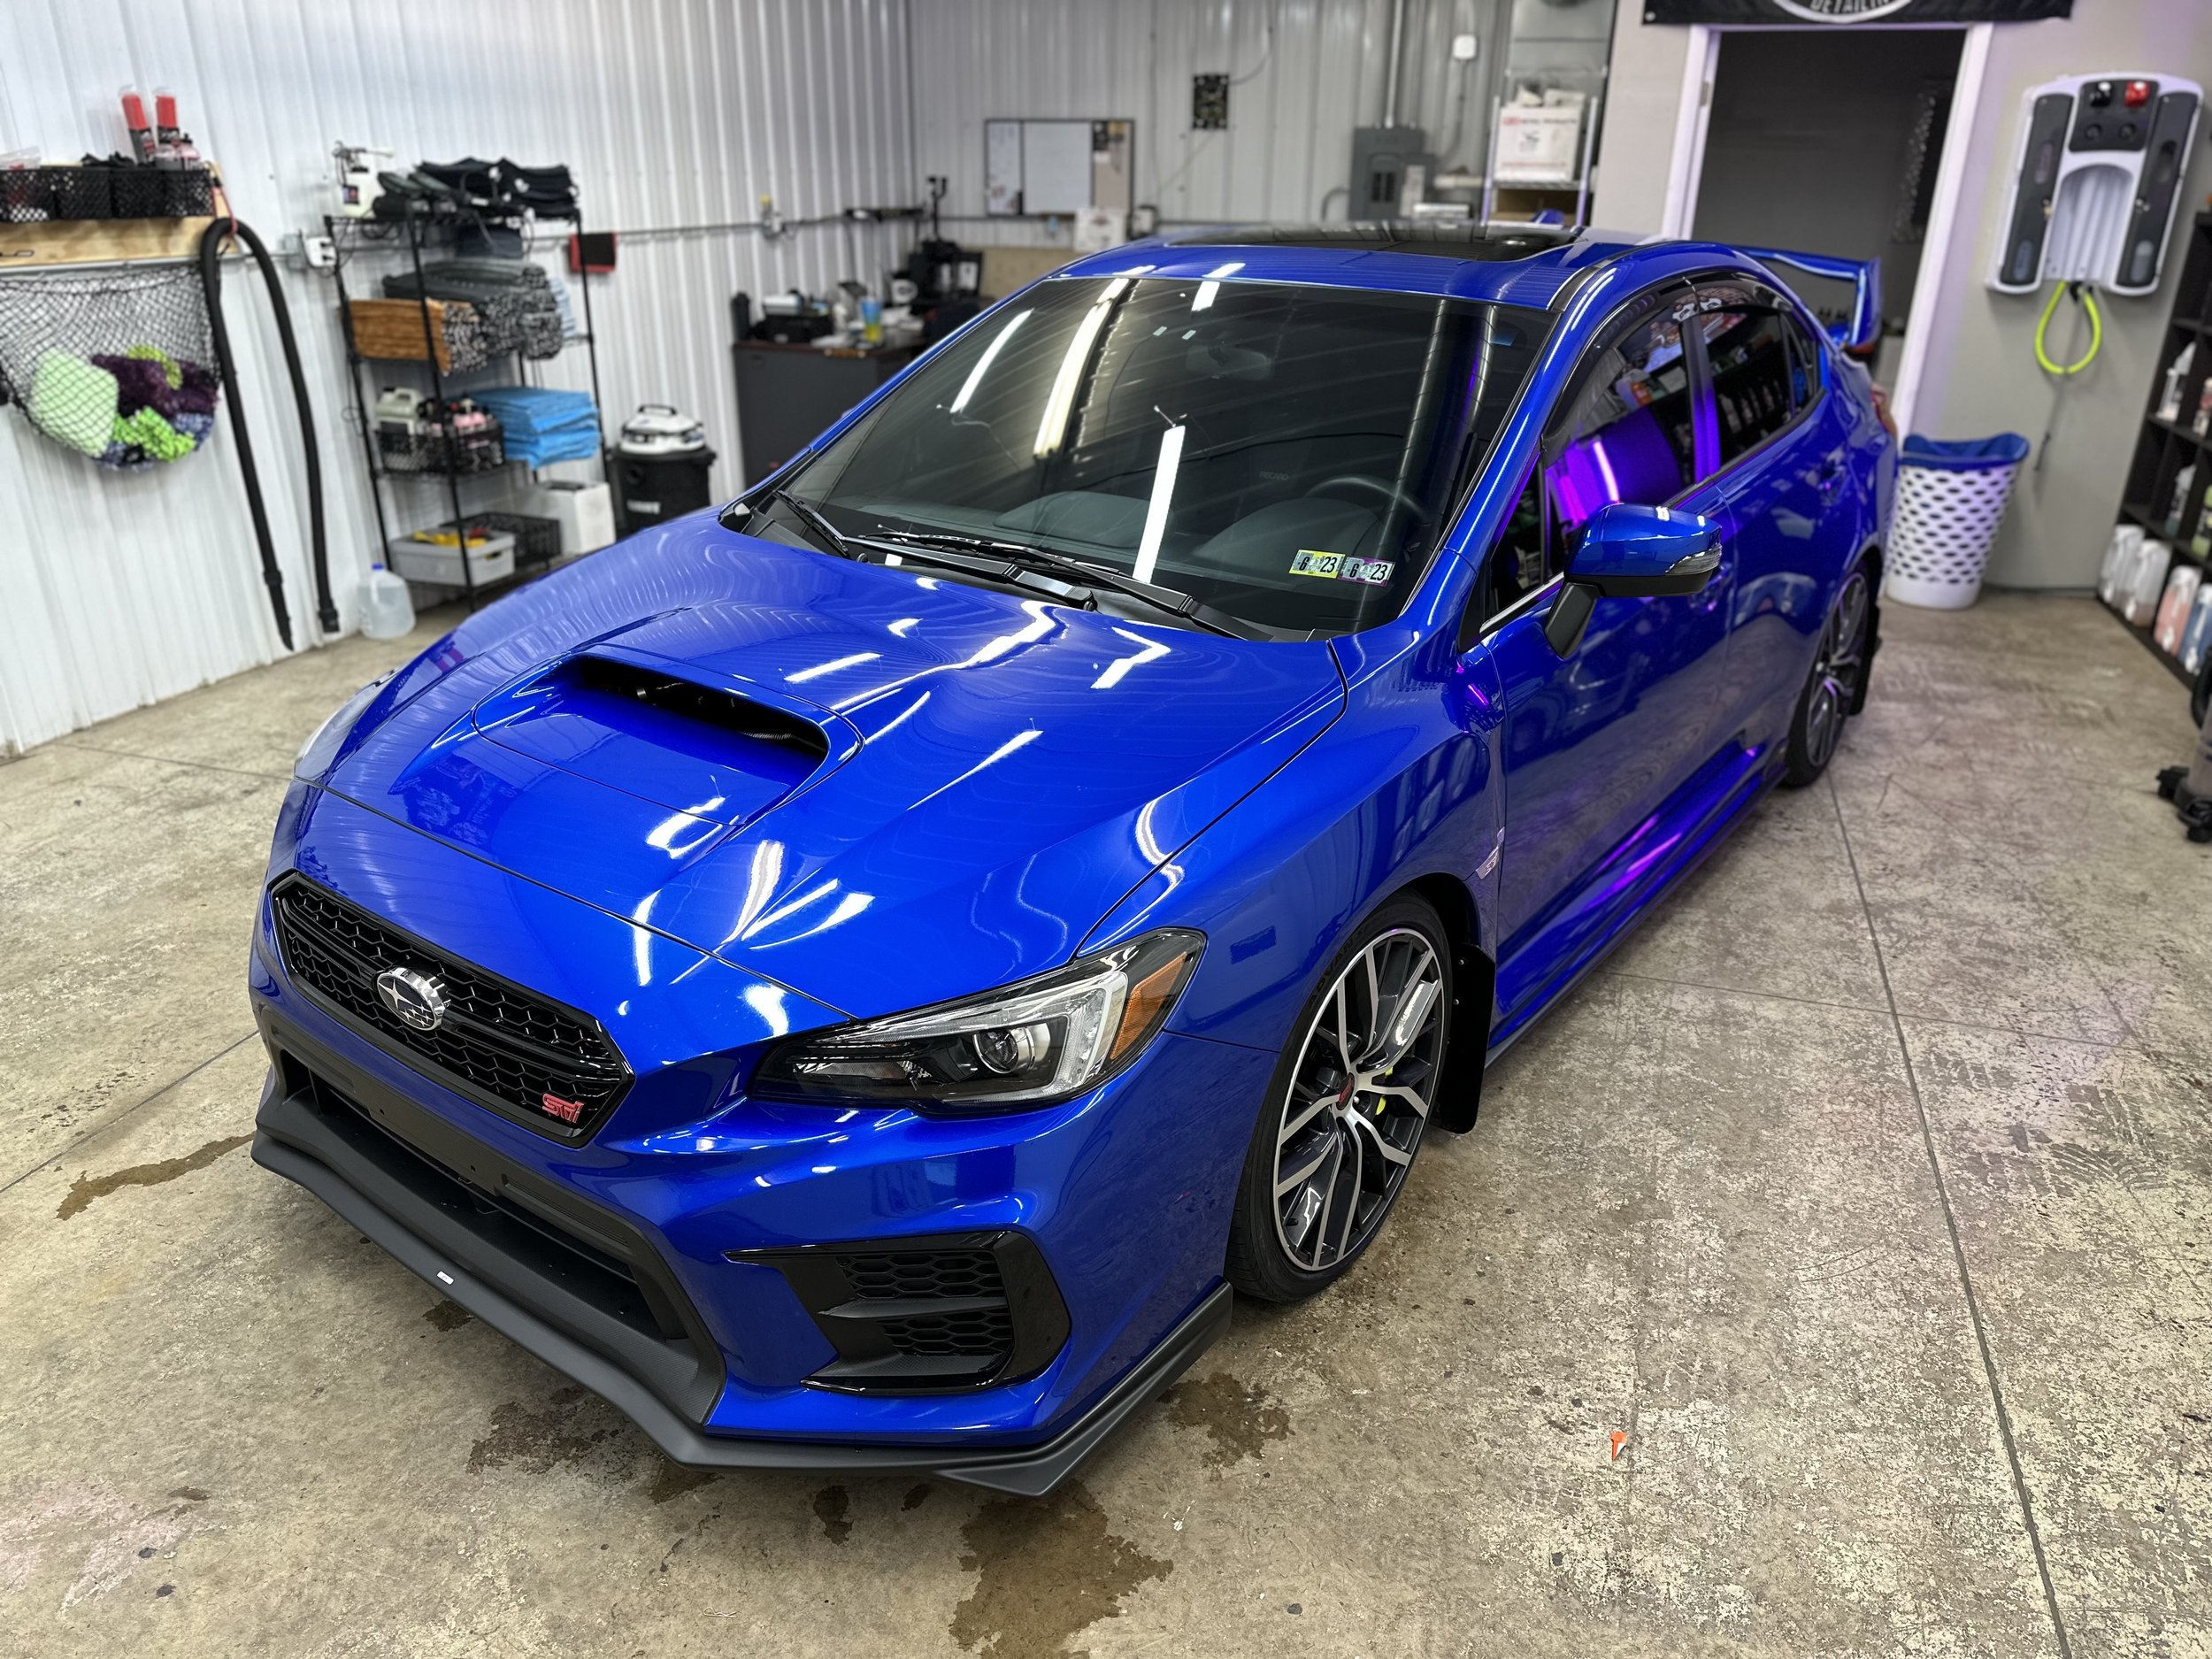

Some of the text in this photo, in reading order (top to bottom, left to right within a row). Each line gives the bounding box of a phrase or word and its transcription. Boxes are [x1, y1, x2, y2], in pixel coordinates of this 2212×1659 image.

[1809, 0, 1890, 14] DETAIL
[1299, 556, 1338, 573] 6 23
[1349, 563, 1388, 581] 6 23
